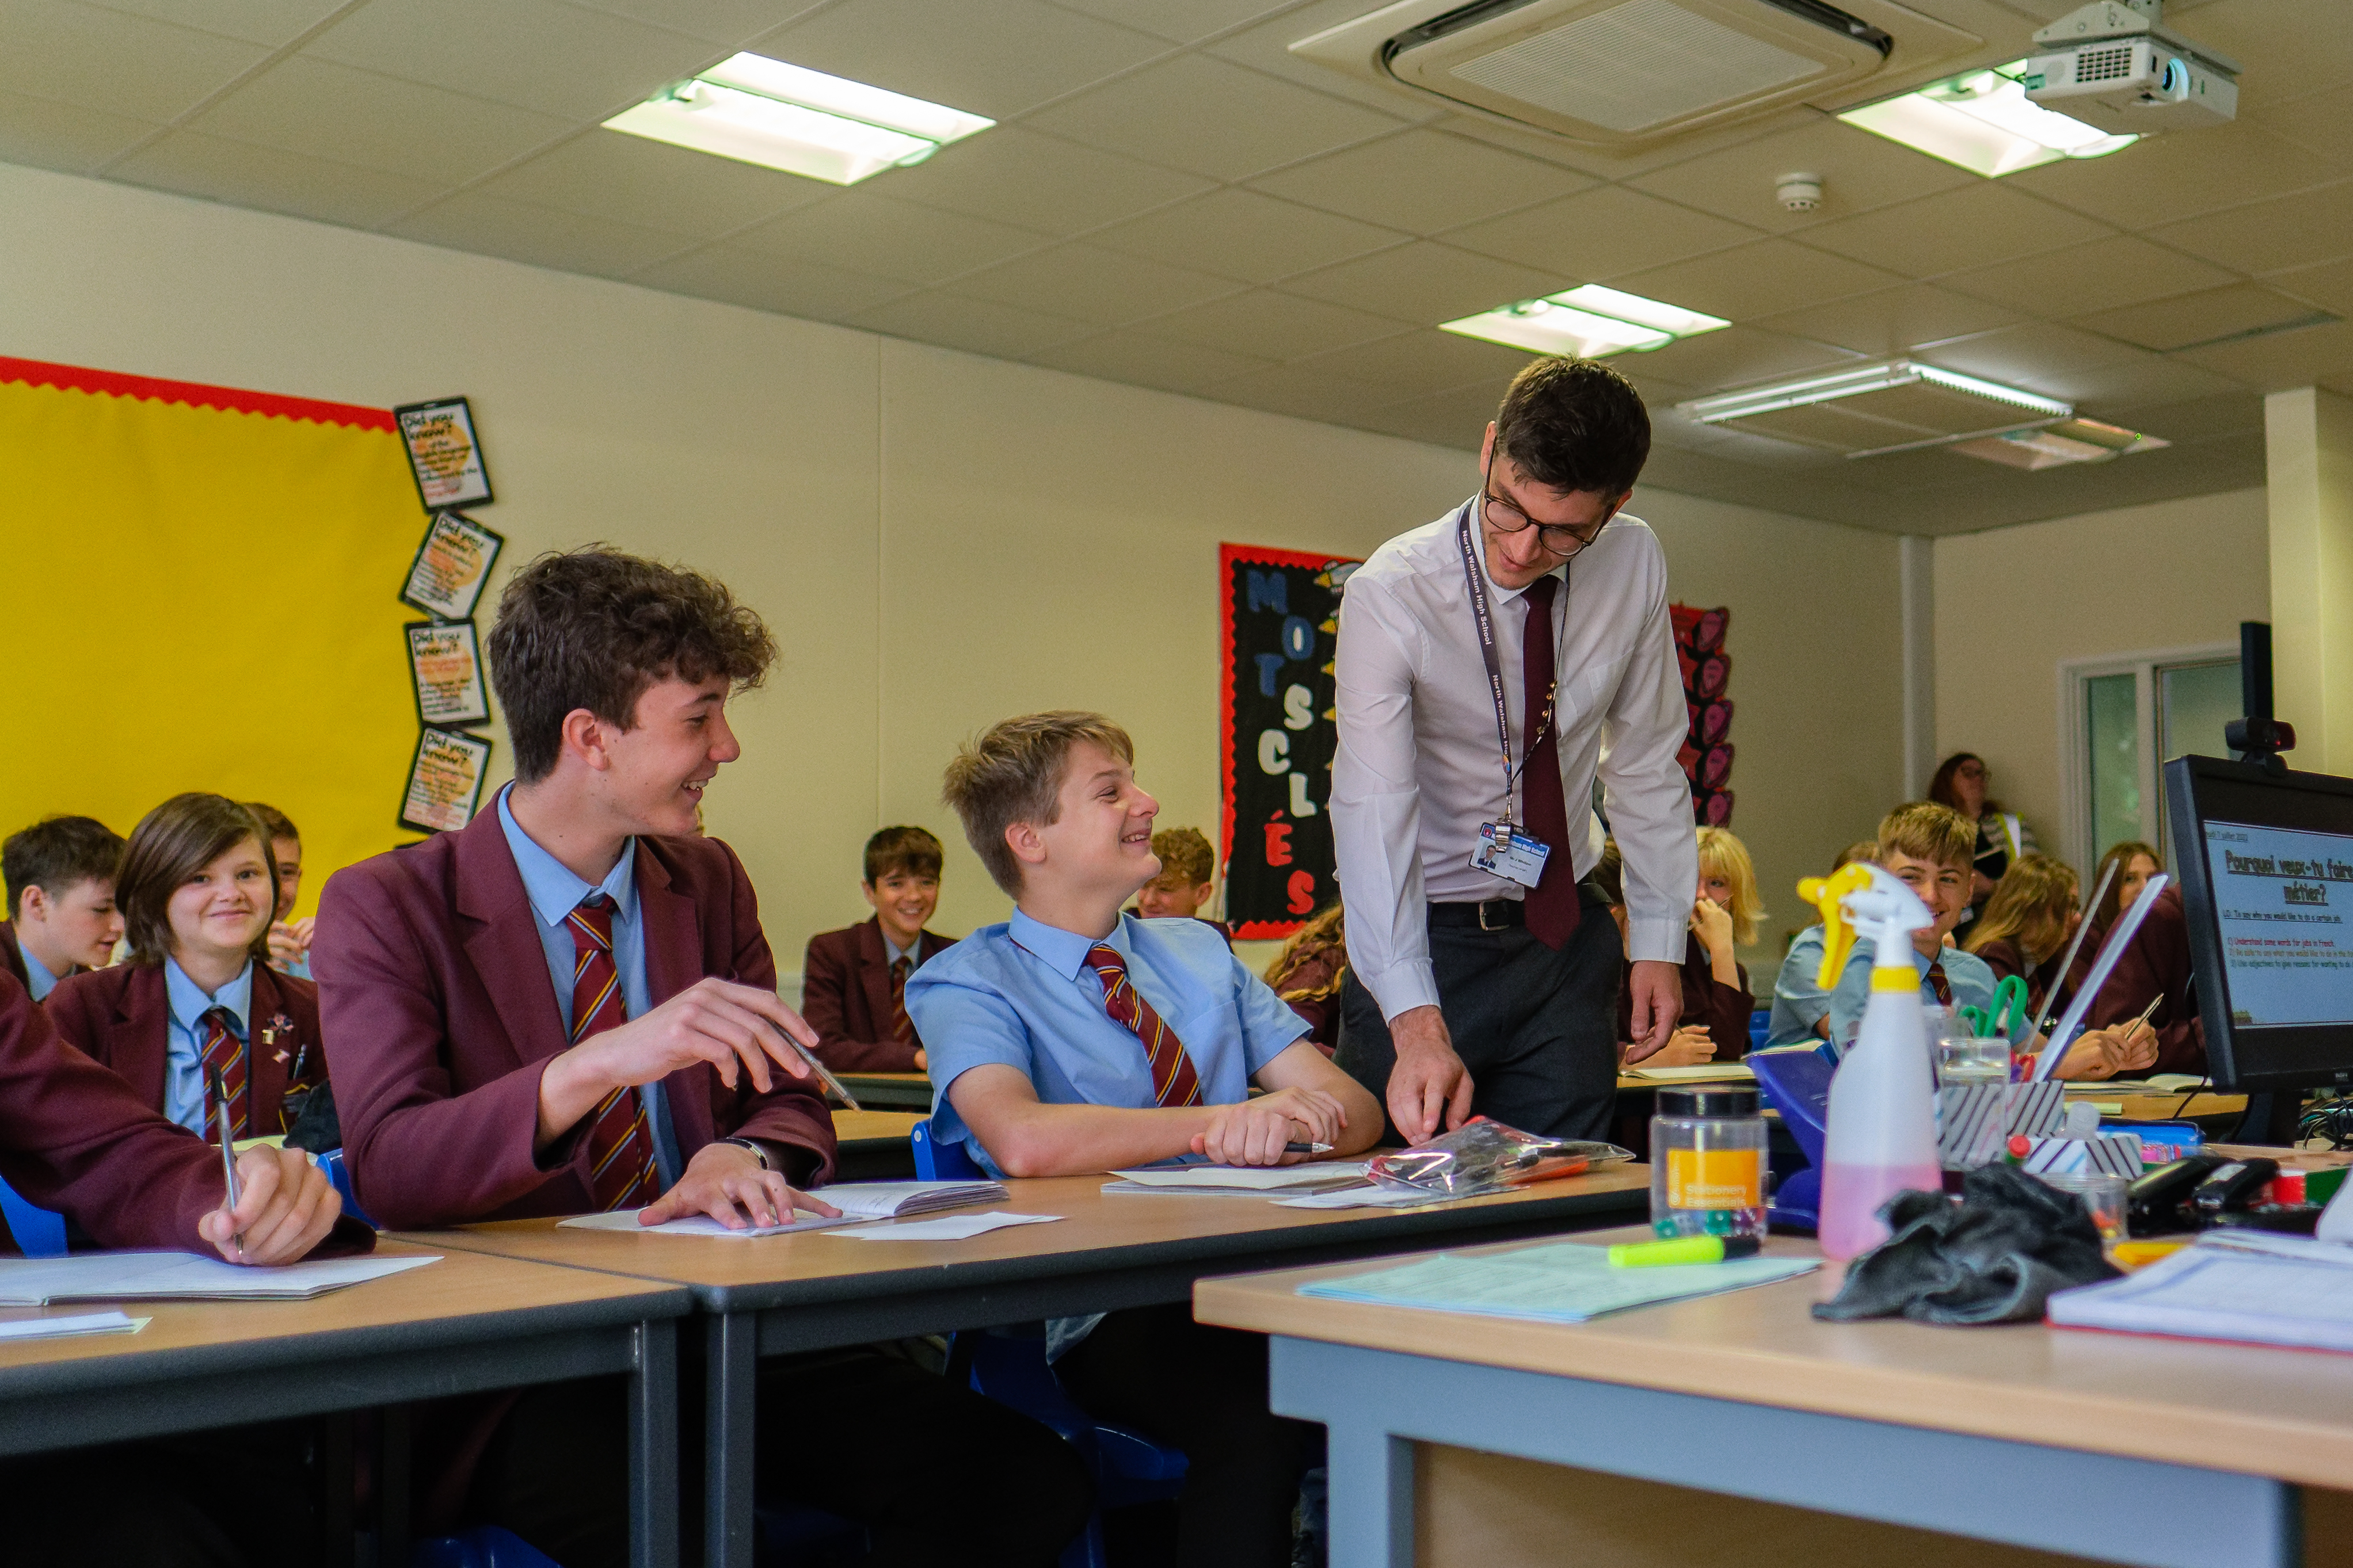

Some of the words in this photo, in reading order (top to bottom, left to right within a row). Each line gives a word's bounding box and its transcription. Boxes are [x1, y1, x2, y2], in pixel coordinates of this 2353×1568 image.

[1462, 529, 1471, 555] North
[1468, 555, 1480, 594] Walsham
[1476, 594, 1485, 615] High
[414, 632, 435, 644] Did
[1480, 615, 1492, 646] School
[1492, 674, 1502, 699] North
[1498, 700, 1507, 739] Walsham
[2225, 849, 2275, 874] Pourquoi
[2283, 880, 2326, 904] métier?
[1686, 1184, 1747, 1196] Stationery
[1686, 1197, 1747, 1207] Essentials
